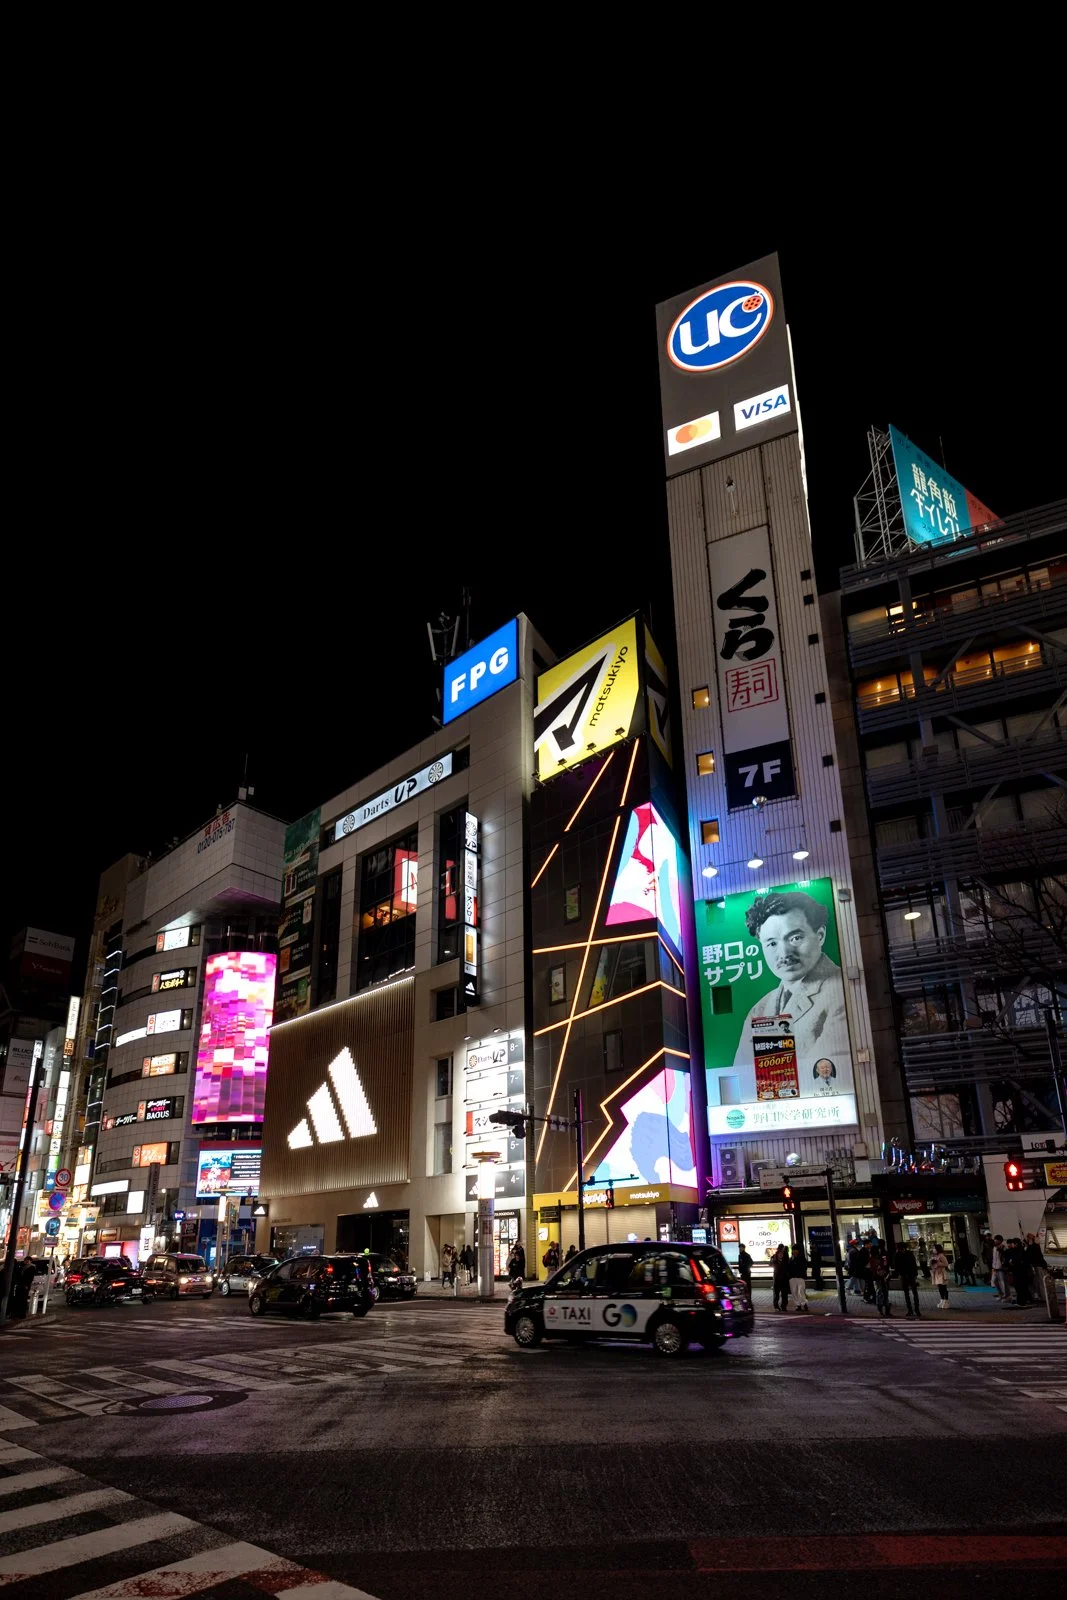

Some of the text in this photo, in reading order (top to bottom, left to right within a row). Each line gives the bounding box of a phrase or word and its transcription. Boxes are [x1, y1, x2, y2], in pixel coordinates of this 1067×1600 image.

[679, 295, 762, 355] UC
[740, 394, 787, 420] VISA
[717, 568, 775, 662] くら
[451, 646, 509, 703] FPG
[589, 646, 628, 727] matsukiyo
[731, 663, 774, 706] 寿司
[738, 759, 781, 788] 7F
[363, 778, 417, 820] Darts UP
[702, 941, 760, 965] 野口の
[704, 960, 763, 986] サプリ
[146, 1110, 170, 1120] BAGUS
[752, 1105, 840, 1124] 野口医学研究所
[59, 1173, 68, 1182] 30
[629, 1190, 660, 1200] matsukiyo
[561, 1306, 591, 1321] TAXI
[602, 1303, 637, 1328] GO
